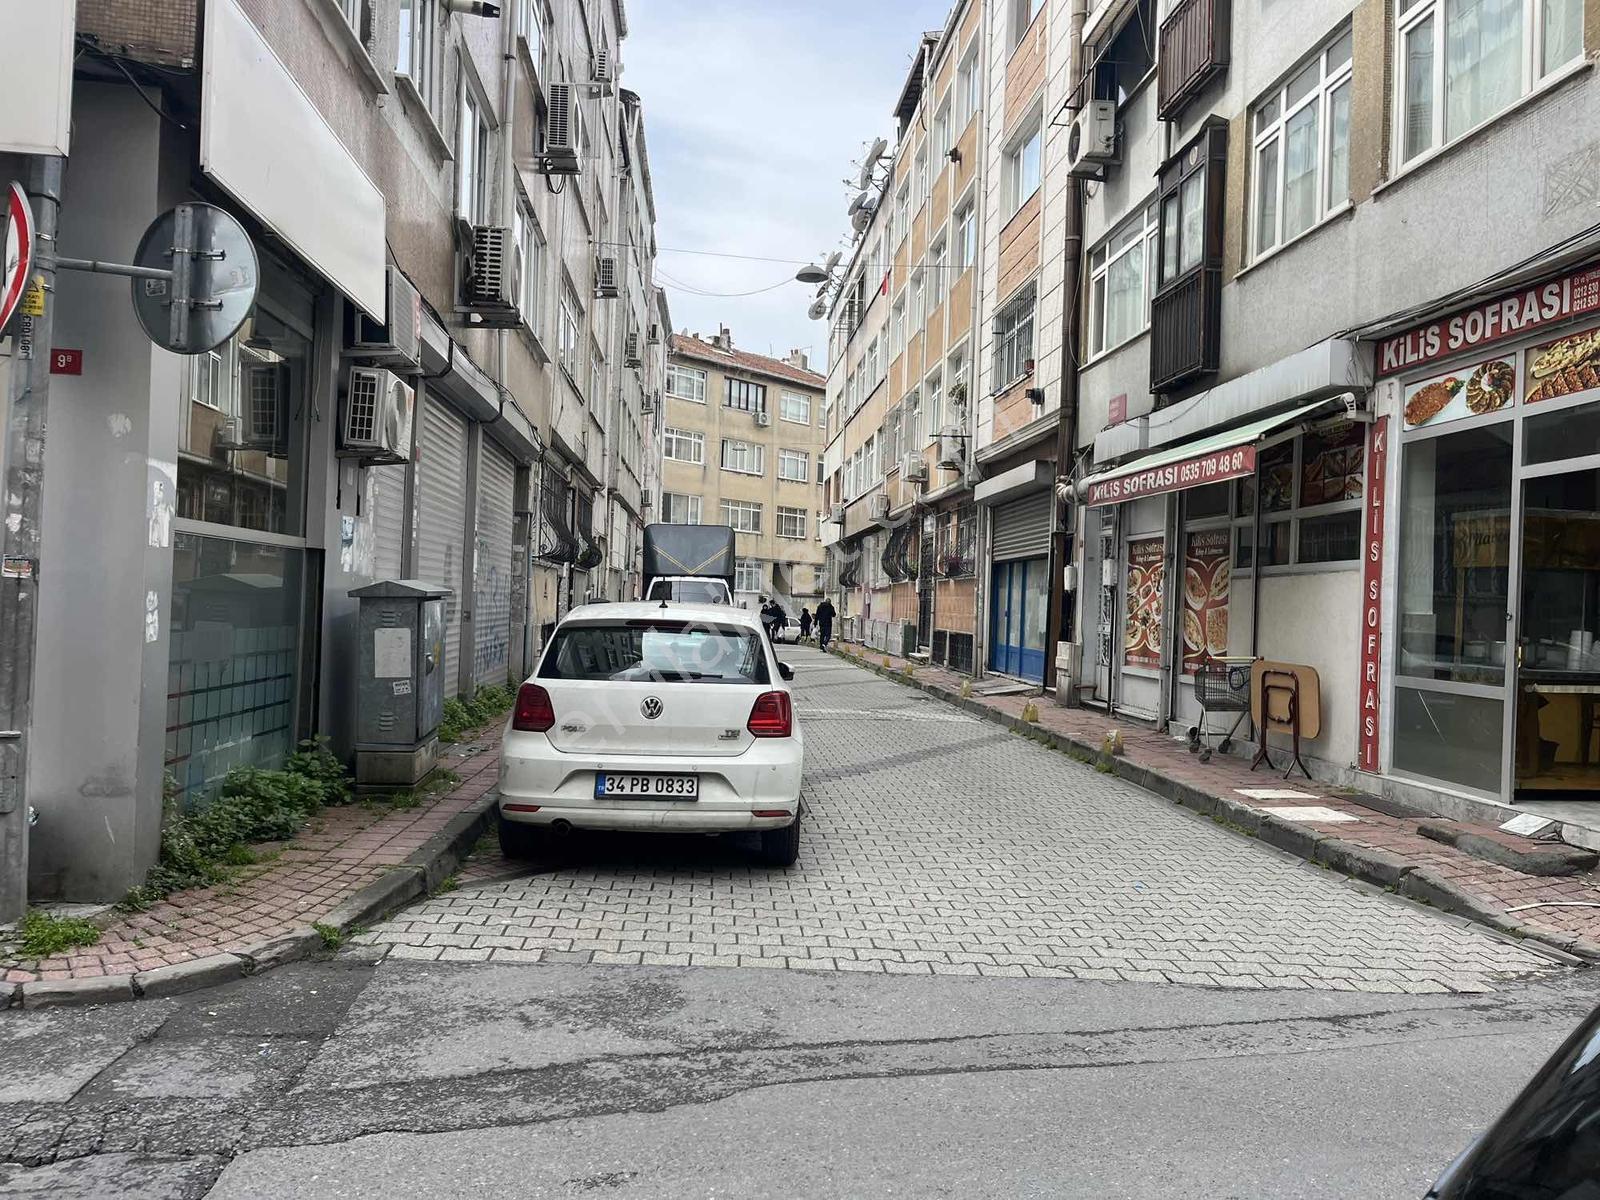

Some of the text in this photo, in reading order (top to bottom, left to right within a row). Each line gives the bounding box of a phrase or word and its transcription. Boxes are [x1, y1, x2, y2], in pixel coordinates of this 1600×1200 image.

[1448, 278, 1571, 350] SOFRASI
[1123, 466, 1178, 495] SOFRASI
[1180, 461, 1200, 483] 0535
[1201, 458, 1217, 478] 709
[1218, 454, 1229, 473] 48
[1231, 451, 1243, 470] 60
[1365, 579, 1378, 765] SOFRASI
[606, 777, 695, 794] 34 PB 0833
